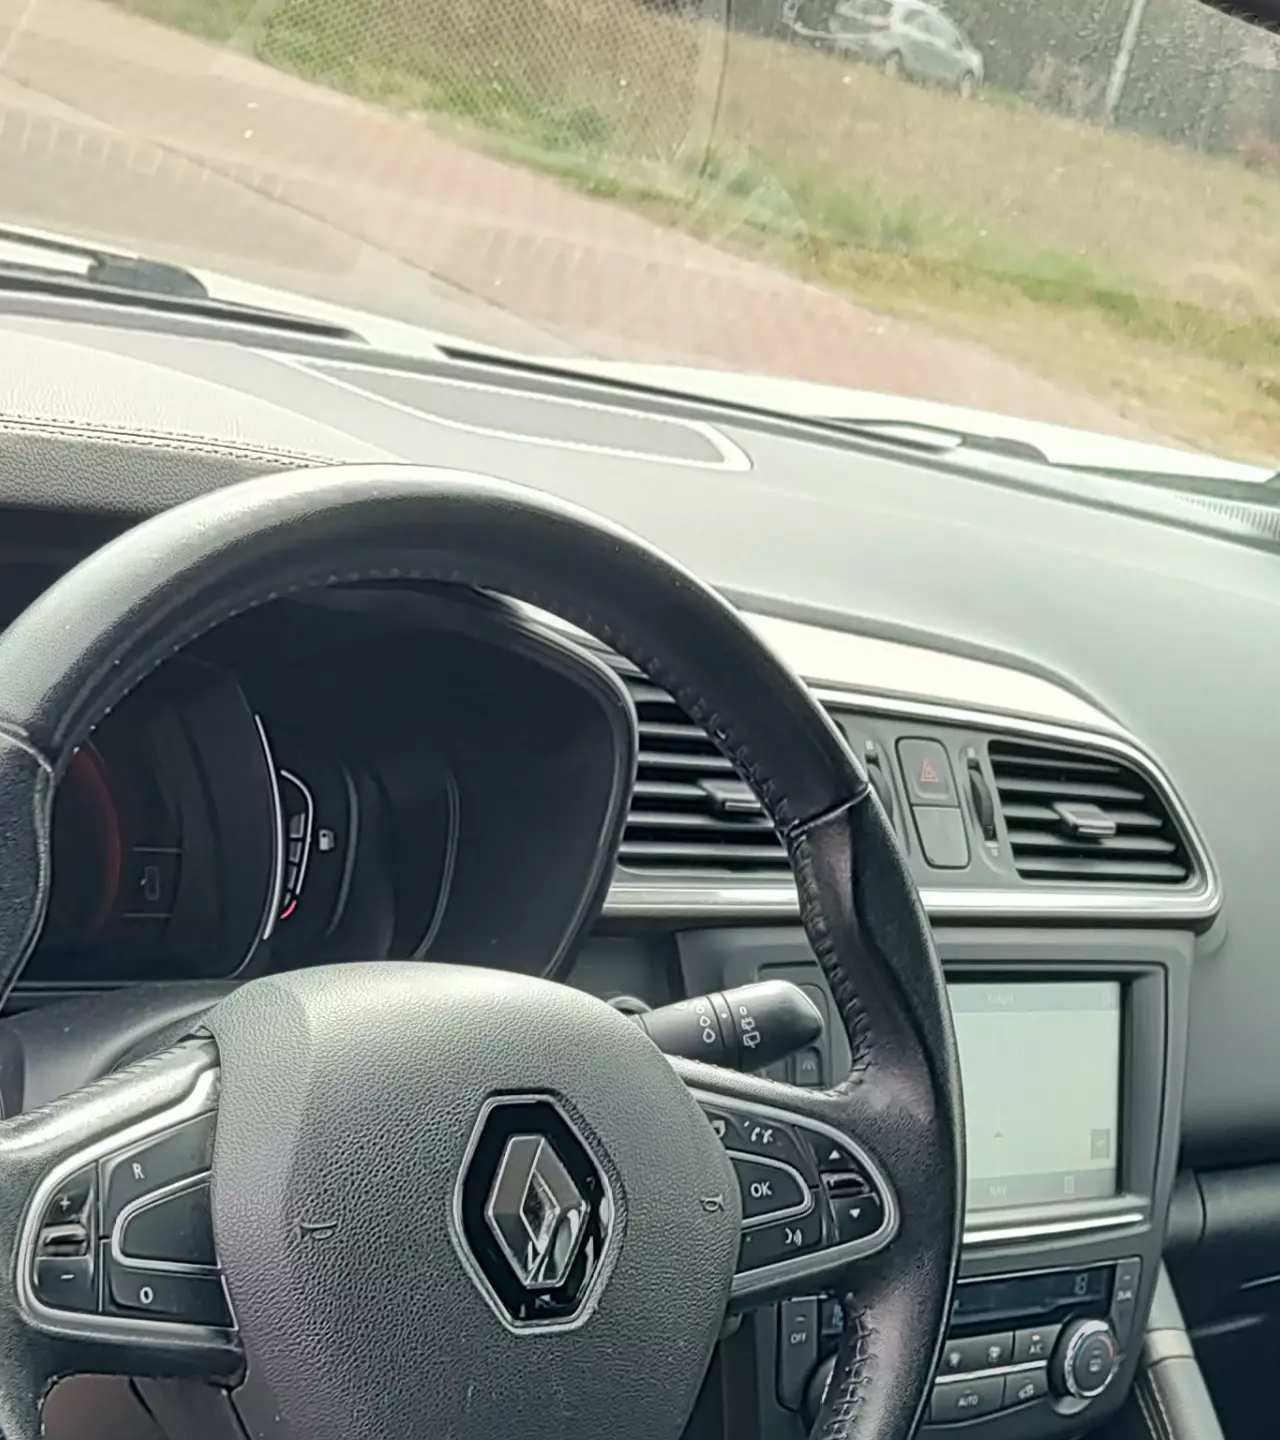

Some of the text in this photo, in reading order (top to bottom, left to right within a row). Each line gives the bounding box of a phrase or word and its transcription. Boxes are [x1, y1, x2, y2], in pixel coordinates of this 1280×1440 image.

[132, 1163, 145, 1180] R
[751, 1181, 772, 1198] OK
[958, 1394, 979, 1407] AUTO
